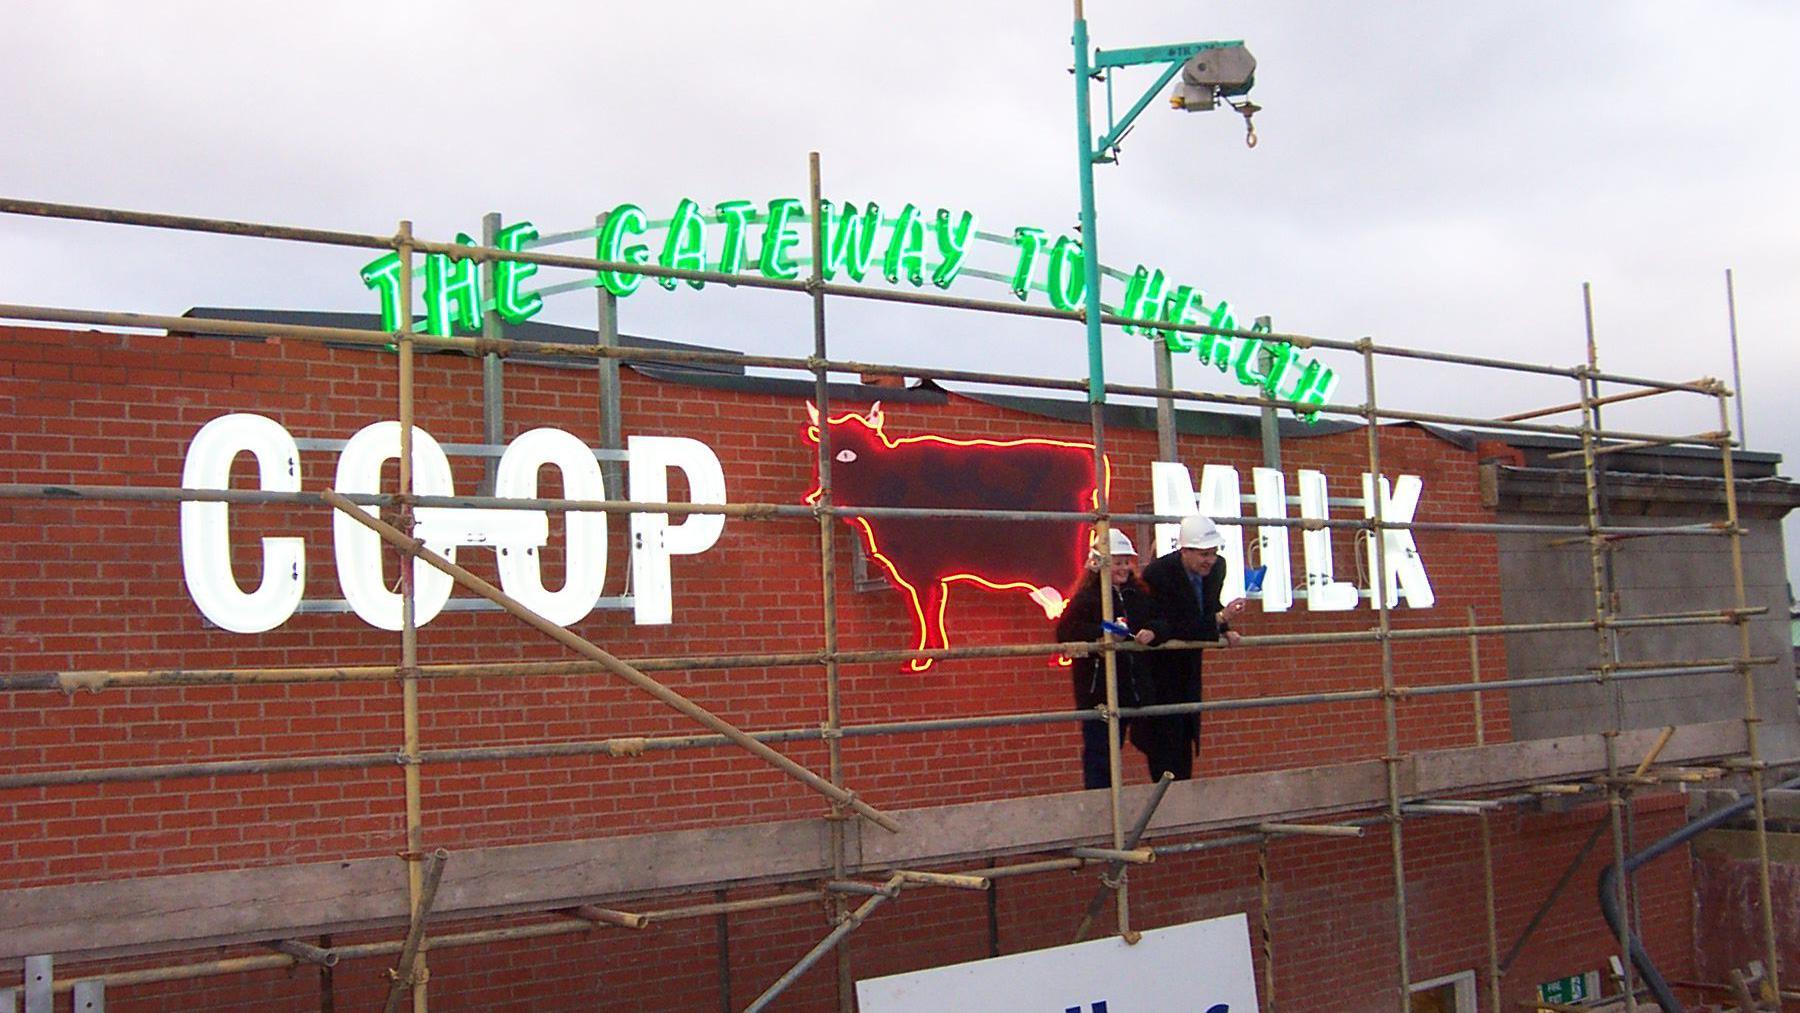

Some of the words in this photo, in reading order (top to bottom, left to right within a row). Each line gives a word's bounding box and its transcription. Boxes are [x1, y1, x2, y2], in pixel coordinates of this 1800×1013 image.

[360, 222, 542, 352] THE
[599, 198, 977, 297] GATEWAY
[1012, 226, 1090, 311] TO
[1122, 264, 1340, 426] HEALTH
[1151, 461, 1435, 612] MILK
